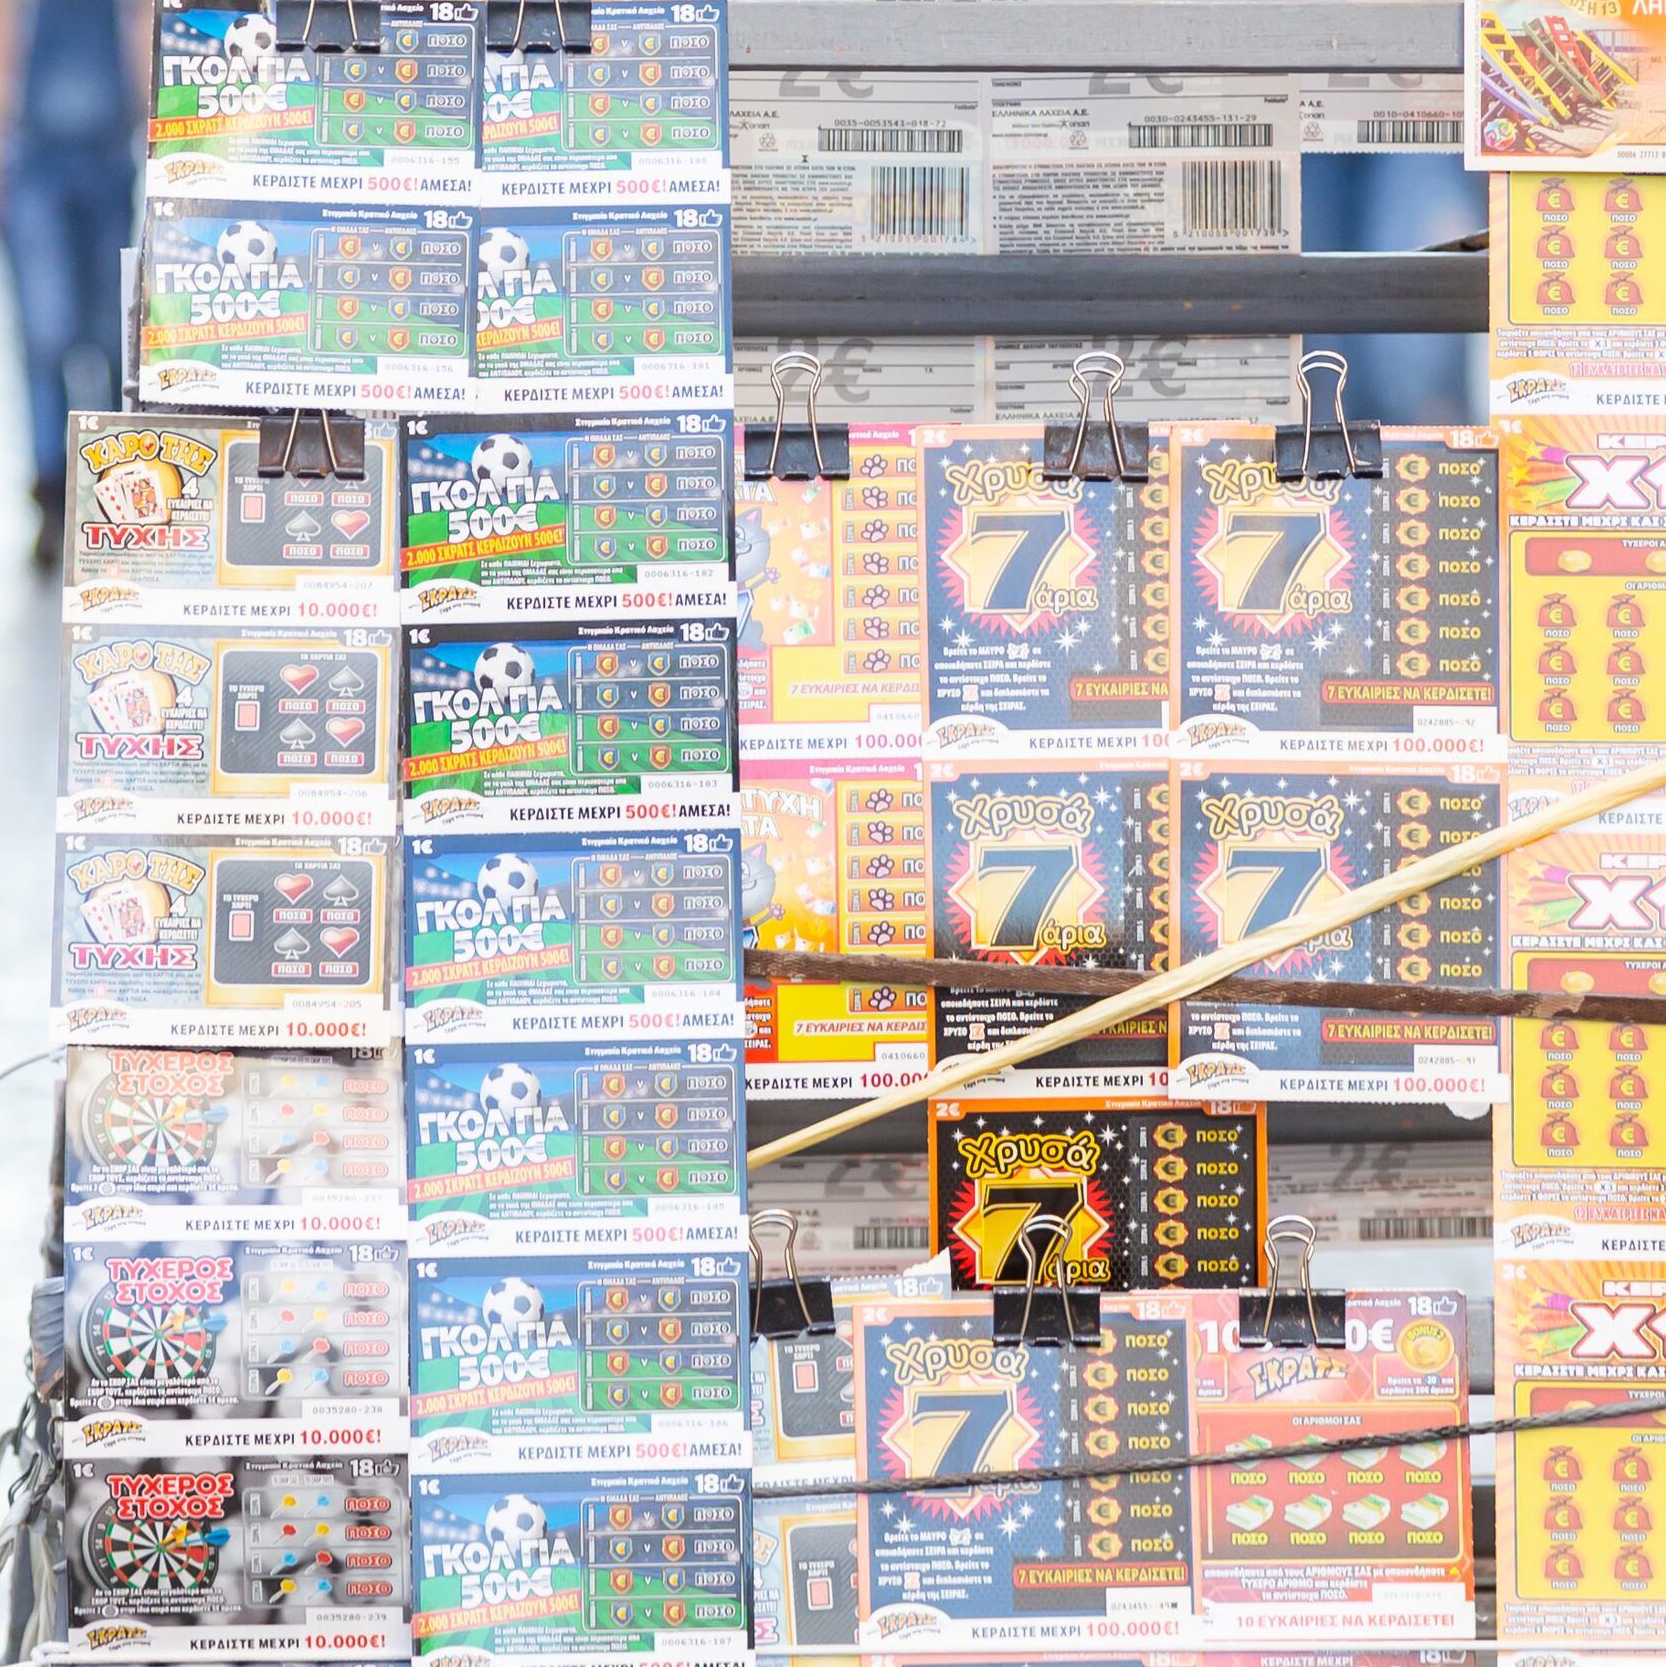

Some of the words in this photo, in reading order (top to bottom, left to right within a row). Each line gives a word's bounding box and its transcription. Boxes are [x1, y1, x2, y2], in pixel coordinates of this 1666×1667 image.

[163, 56, 253, 86] ΓΚΟΛ
[257, 56, 312, 82] ΓΙΑ
[197, 84, 288, 117] 500€
[407, 420, 427, 435] 1€
[677, 415, 700, 433] 18
[82, 431, 159, 475] ΚΑΡΟ
[160, 433, 217, 475] ΤΗΣ
[411, 476, 501, 514] ΓΚΟΛ
[507, 476, 561, 502] ΓΙΑ
[448, 503, 540, 543] 500€
[83, 523, 209, 550] ΤΥΧΗΣ
[406, 549, 436, 566] 2.000
[437, 542, 475, 561] ΣΚΡΑΤΣ
[477, 535, 532, 554] ΚΕΡΔΙΖΟΥΝ
[534, 529, 563, 545] 500€!
[183, 604, 246, 616] ΚΕΡΔΙΣΤΕ
[252, 605, 290, 617] ΜΕΧΡΙ
[298, 603, 378, 617] 10.000€!
[507, 596, 571, 610] ΚΕΡΔΙΣΤΕ
[575, 596, 617, 609] ΜΕΧΡΙ
[622, 593, 673, 608] 500€!
[675, 593, 726, 607] ΑΜΕΣΑ!
[1327, 686, 1336, 699] 7
[1337, 686, 1400, 701] ΕΥΚΑΙΡΙΕΣ
[1403, 686, 1421, 700] ΝΑ
[1423, 687, 1491, 701] ΚΕΡΔΙΣΕΤΕ!
[1280, 740, 1344, 751] ΚΕΡΔΙΣΤΕ
[1349, 740, 1388, 751] ΜΕΧΡΙ
[1394, 739, 1484, 753] 100.000€!
[936, 1103, 960, 1117] 2€
[1602, 1239, 1665, 1252] ΚΕΡΔΙΣΤΕ
[107, 1473, 235, 1497] ΤΥΧΕΡΟΣ
[117, 1497, 225, 1520] ΣΤΟΧΟΣ
[1238, 1615, 1254, 1628] 10
[1258, 1615, 1337, 1629] ΕΥΚΑΙΡΙΕΣ
[1342, 1615, 1366, 1628] ΝΑ
[1371, 1614, 1455, 1627] ΚΕΡΔΙΣΕΤΕ!
[191, 1639, 254, 1650] ΚΕΡΔΙΣΤΕ
[260, 1638, 299, 1649] ΜΕΧΡΙ
[305, 1635, 385, 1650] 10.000€!
